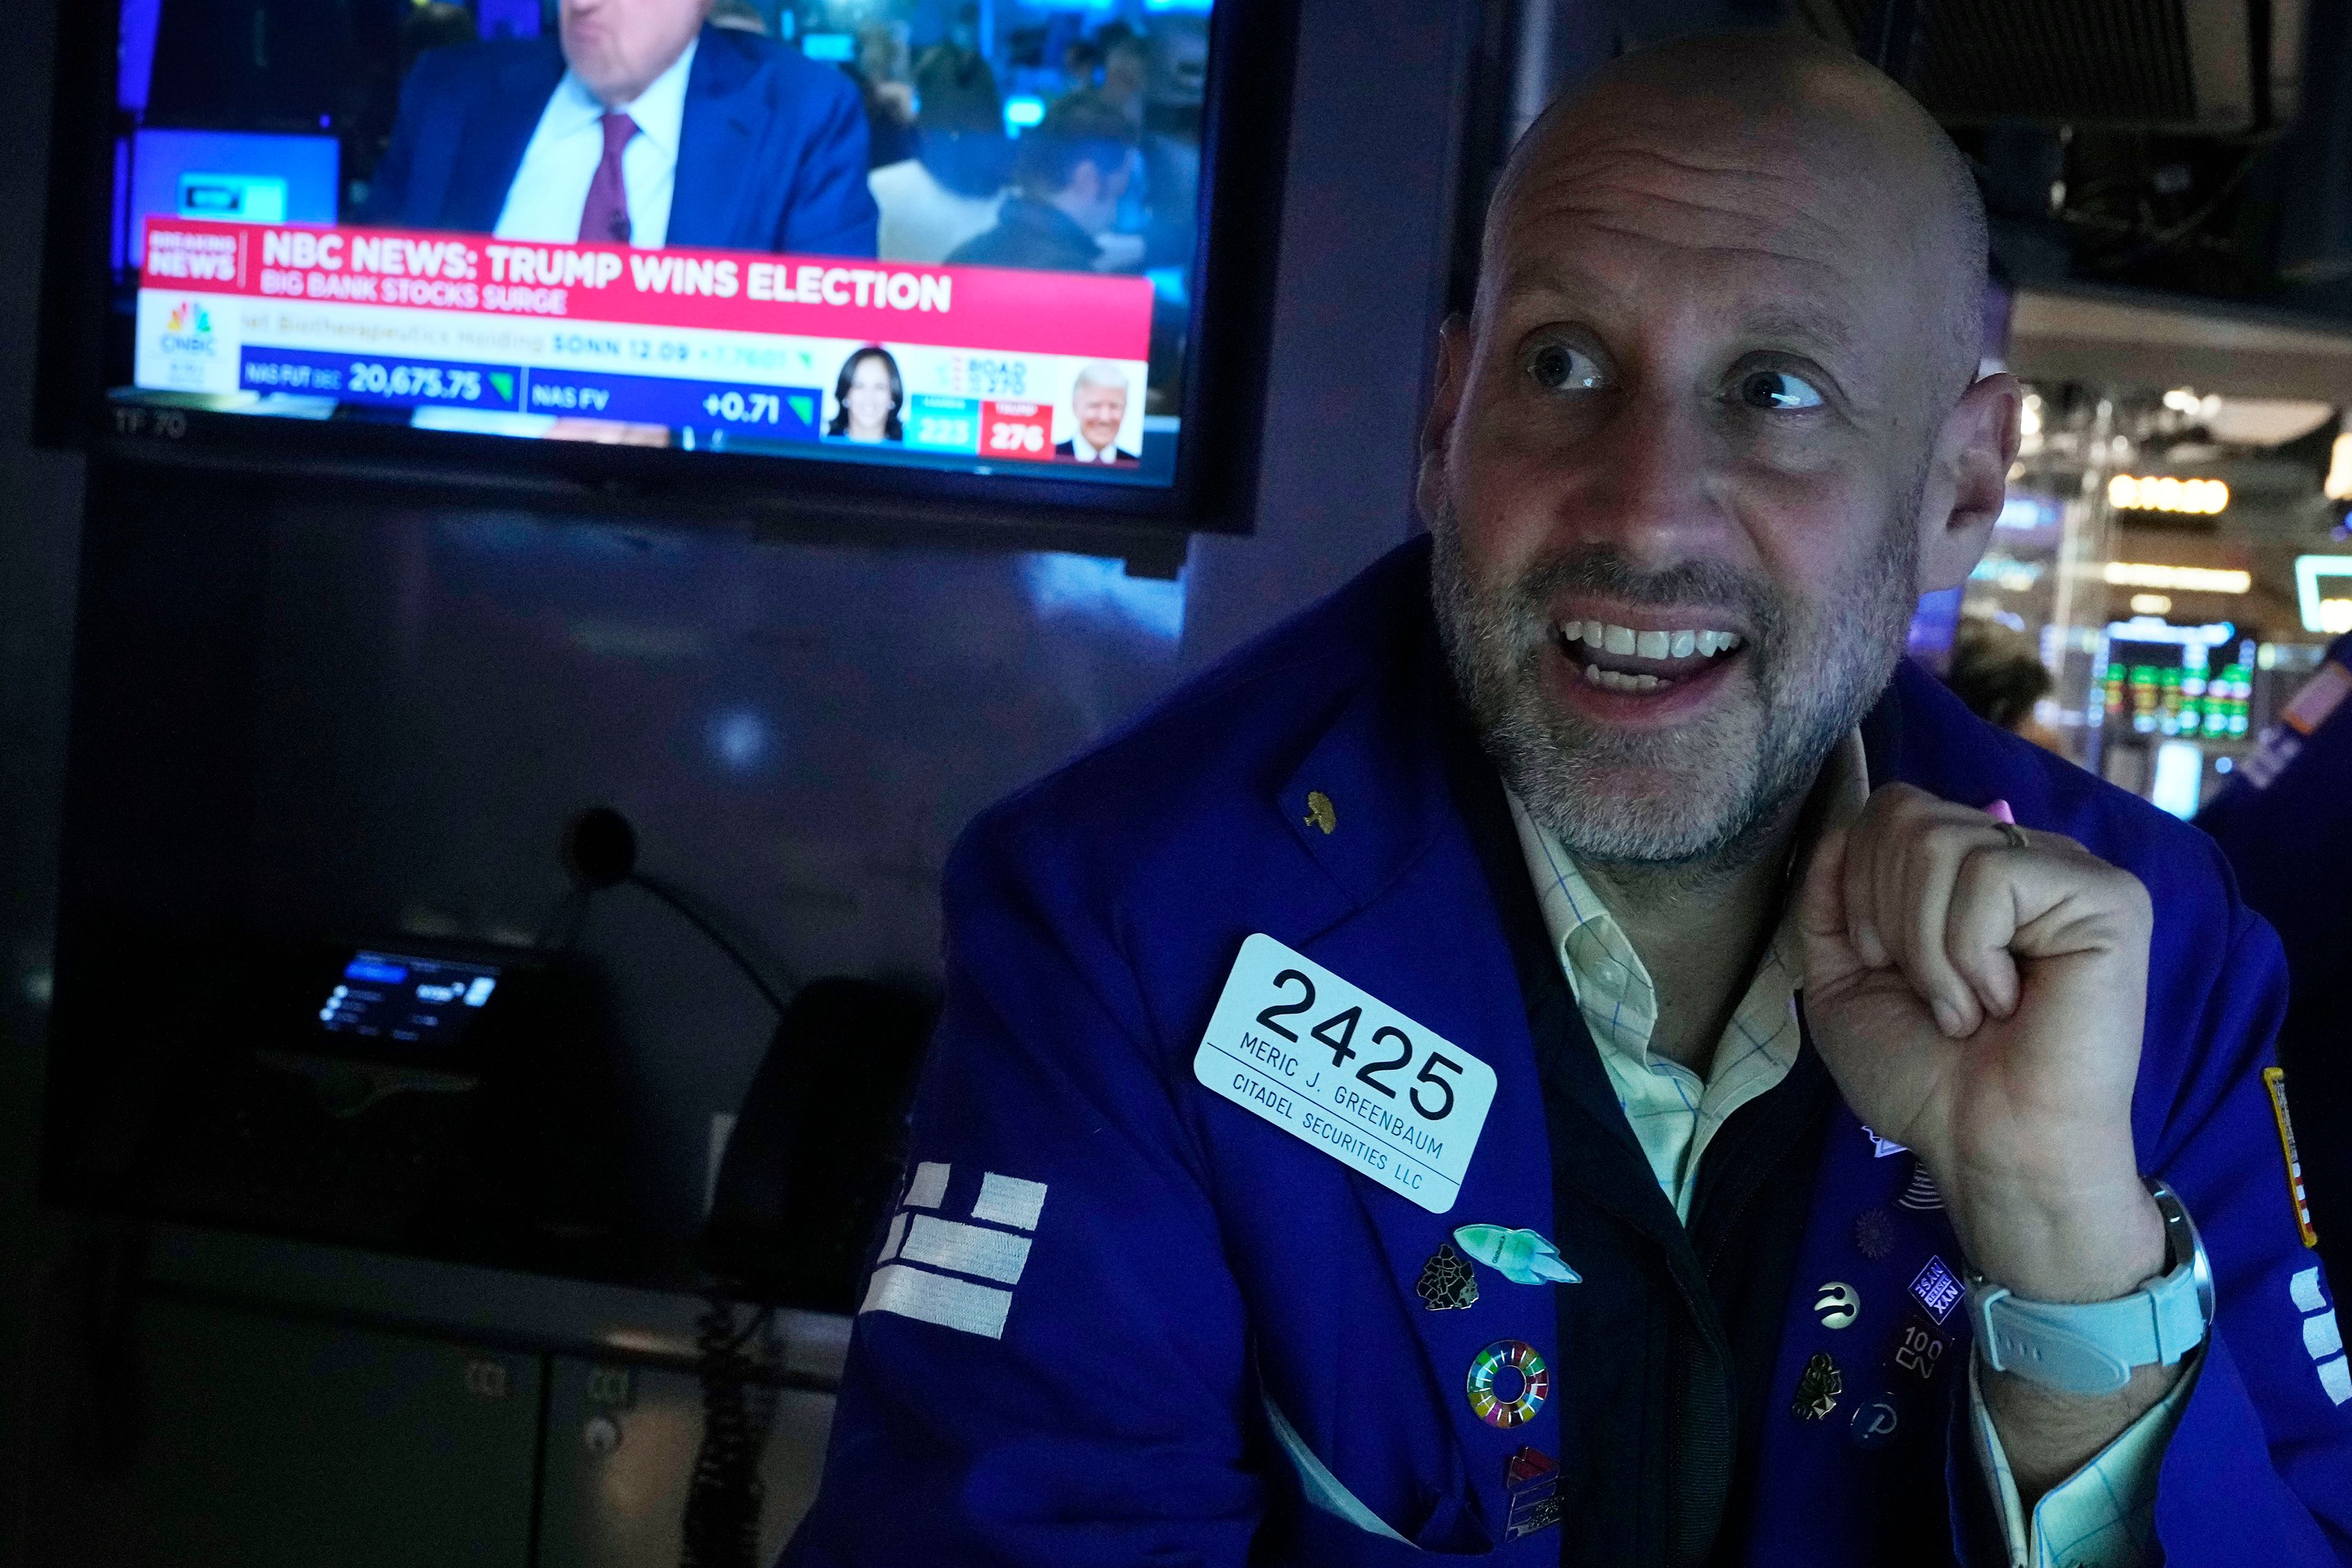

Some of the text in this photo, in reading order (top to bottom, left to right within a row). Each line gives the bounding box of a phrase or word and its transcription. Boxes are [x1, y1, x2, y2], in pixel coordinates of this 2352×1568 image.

[148, 251, 236, 281] NEWS
[263, 230, 952, 313] NBC NEWS: TRUMP WINS ELECTION
[260, 268, 568, 315] BIG BANK STOCKS SURGE
[160, 333, 216, 356] CNBC
[553, 332, 620, 355] SONN
[629, 337, 690, 361] 12.09
[348, 362, 481, 401] 20,675.75
[969, 359, 1027, 375] ROAD
[532, 383, 610, 411] NAS FV
[703, 391, 779, 425] +0.71
[990, 422, 1044, 452] 276
[1256, 968, 1463, 1121] 2425
[1240, 1031, 1444, 1159] MERIC J. GREENBAUM
[1232, 1074, 1423, 1190] CITADEL SECURITIES LLC
[1915, 1262, 1944, 1297] NYSE
[1933, 1285, 1959, 1314] NYX
[1905, 1327, 1943, 1360] 100
